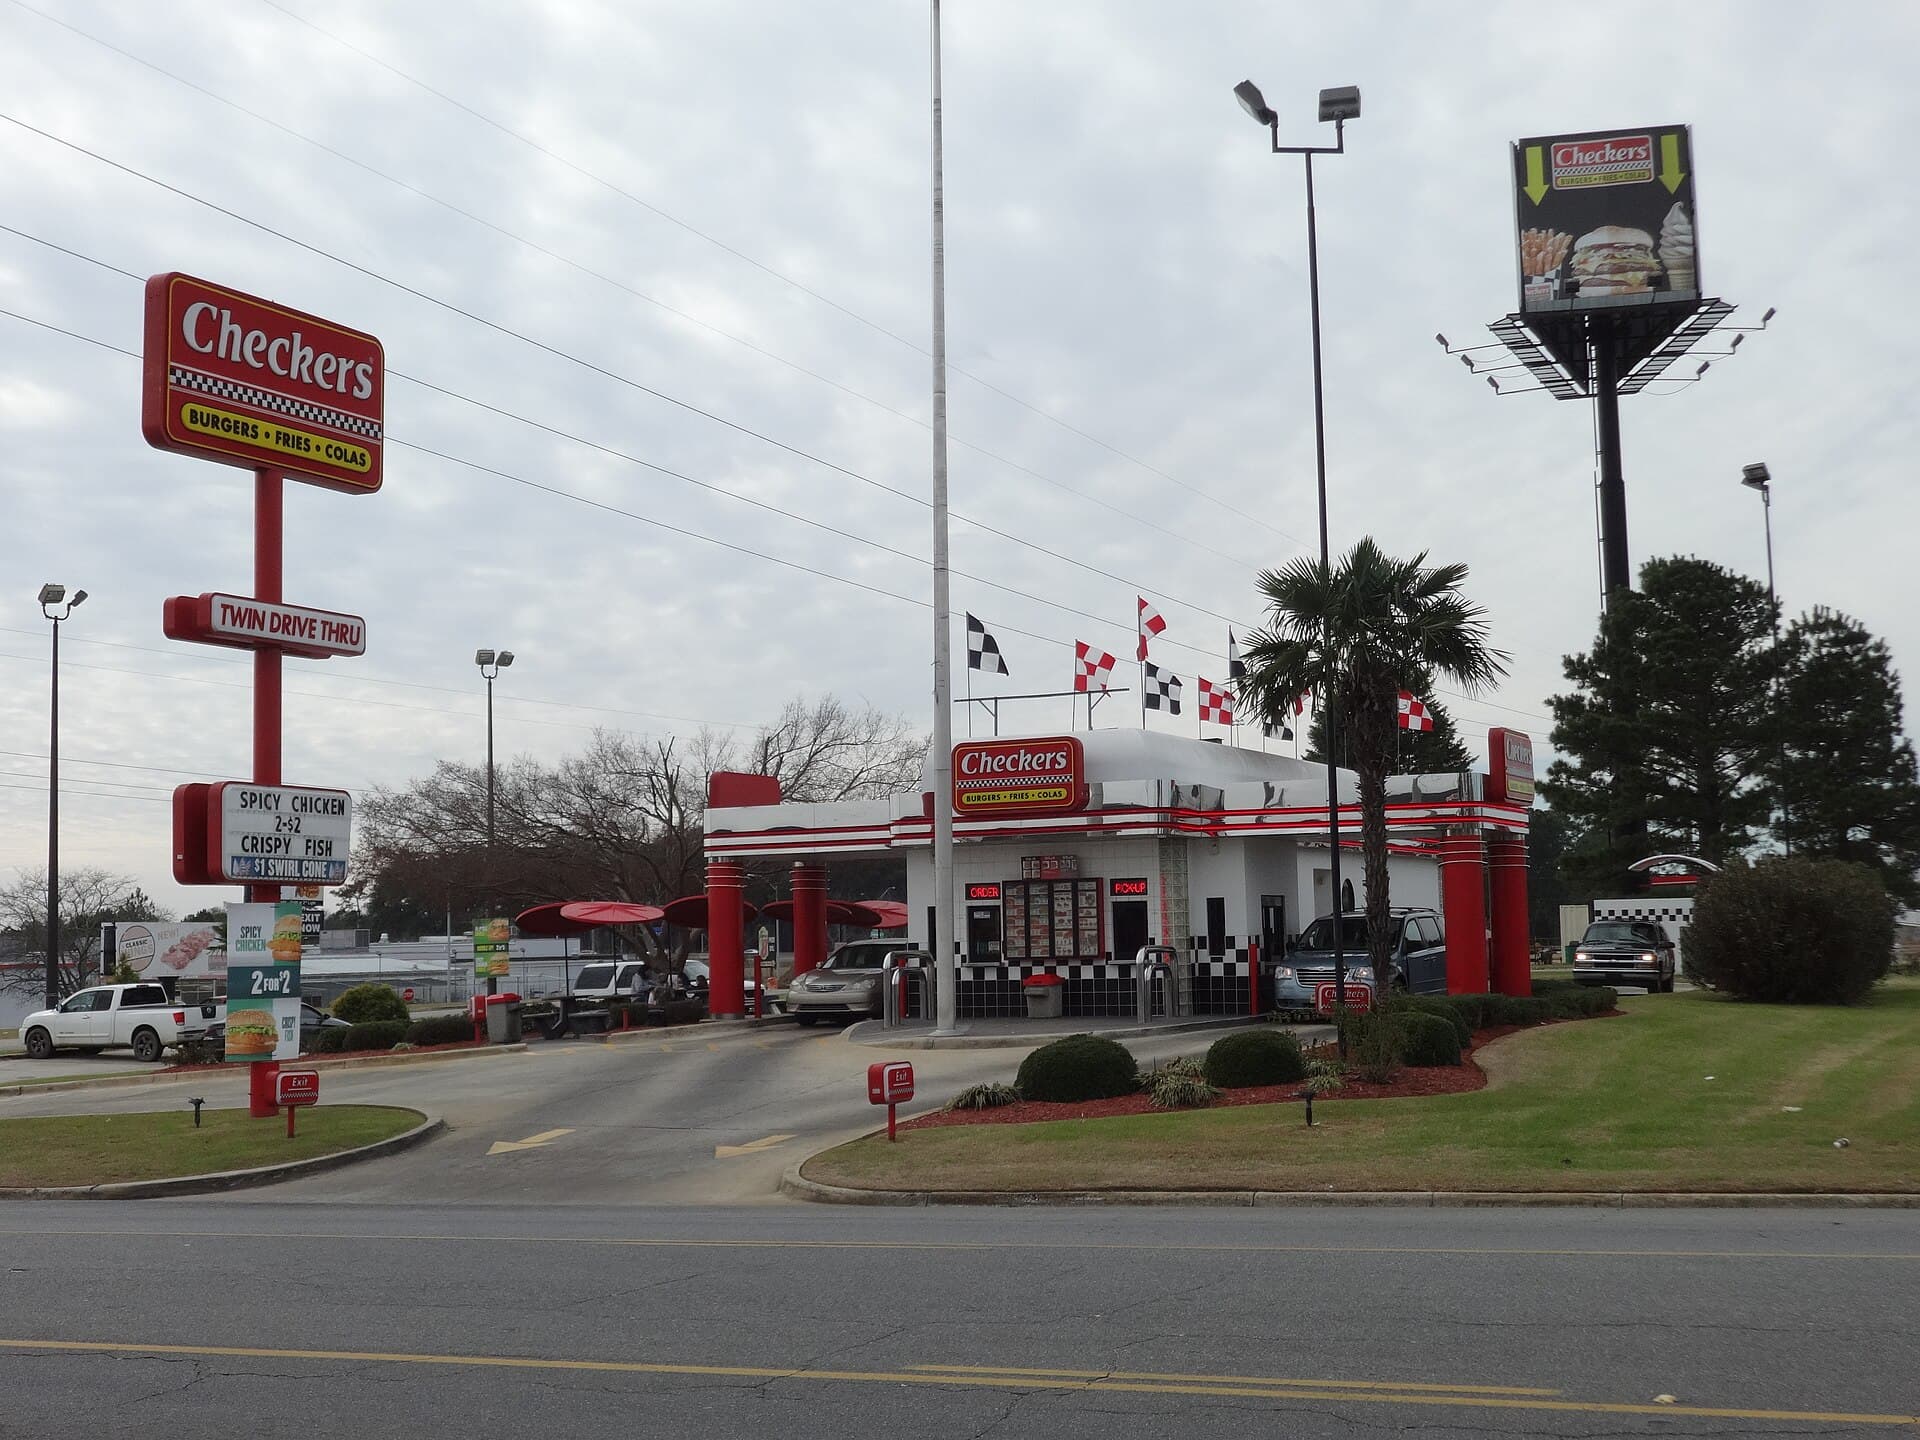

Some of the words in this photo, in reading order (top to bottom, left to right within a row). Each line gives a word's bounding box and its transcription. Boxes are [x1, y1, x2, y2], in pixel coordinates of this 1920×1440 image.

[1556, 143, 1648, 166] Checkers
[1561, 176, 1593, 185] BURGERS
[1599, 174, 1618, 182] FRIES
[182, 302, 373, 400] Checkers
[189, 408, 259, 440] BURGERS
[275, 430, 311, 453] FRIES
[325, 444, 367, 467] COLAS
[221, 604, 266, 631] TWIN
[269, 611, 317, 640] DRIVE
[320, 620, 361, 646] THRU
[961, 750, 1067, 775] Checkers
[240, 791, 281, 811] SPICY
[291, 796, 345, 816] CHICKEN
[966, 793, 1001, 803] BURGERS
[1009, 792, 1030, 801] FRIES
[1037, 790, 1063, 799] COLAS
[275, 816, 301, 833] 2-$2
[241, 835, 292, 855] CRISPY
[305, 839, 333, 857] FISH
[254, 858, 265, 876] $1
[267, 858, 300, 878] SWIRL
[302, 861, 328, 878] CONE
[970, 886, 999, 898] ORDER
[240, 925, 262, 939] SPICY
[125, 939, 148, 949] CLASSIC
[235, 939, 266, 952] CHICKEN
[251, 970, 263, 995] 2
[263, 977, 280, 992] FOR
[279, 970, 291, 994] $2
[1324, 989, 1364, 998] Chkers
[292, 1076, 308, 1087] Exit
[895, 1070, 907, 1082] Exit
